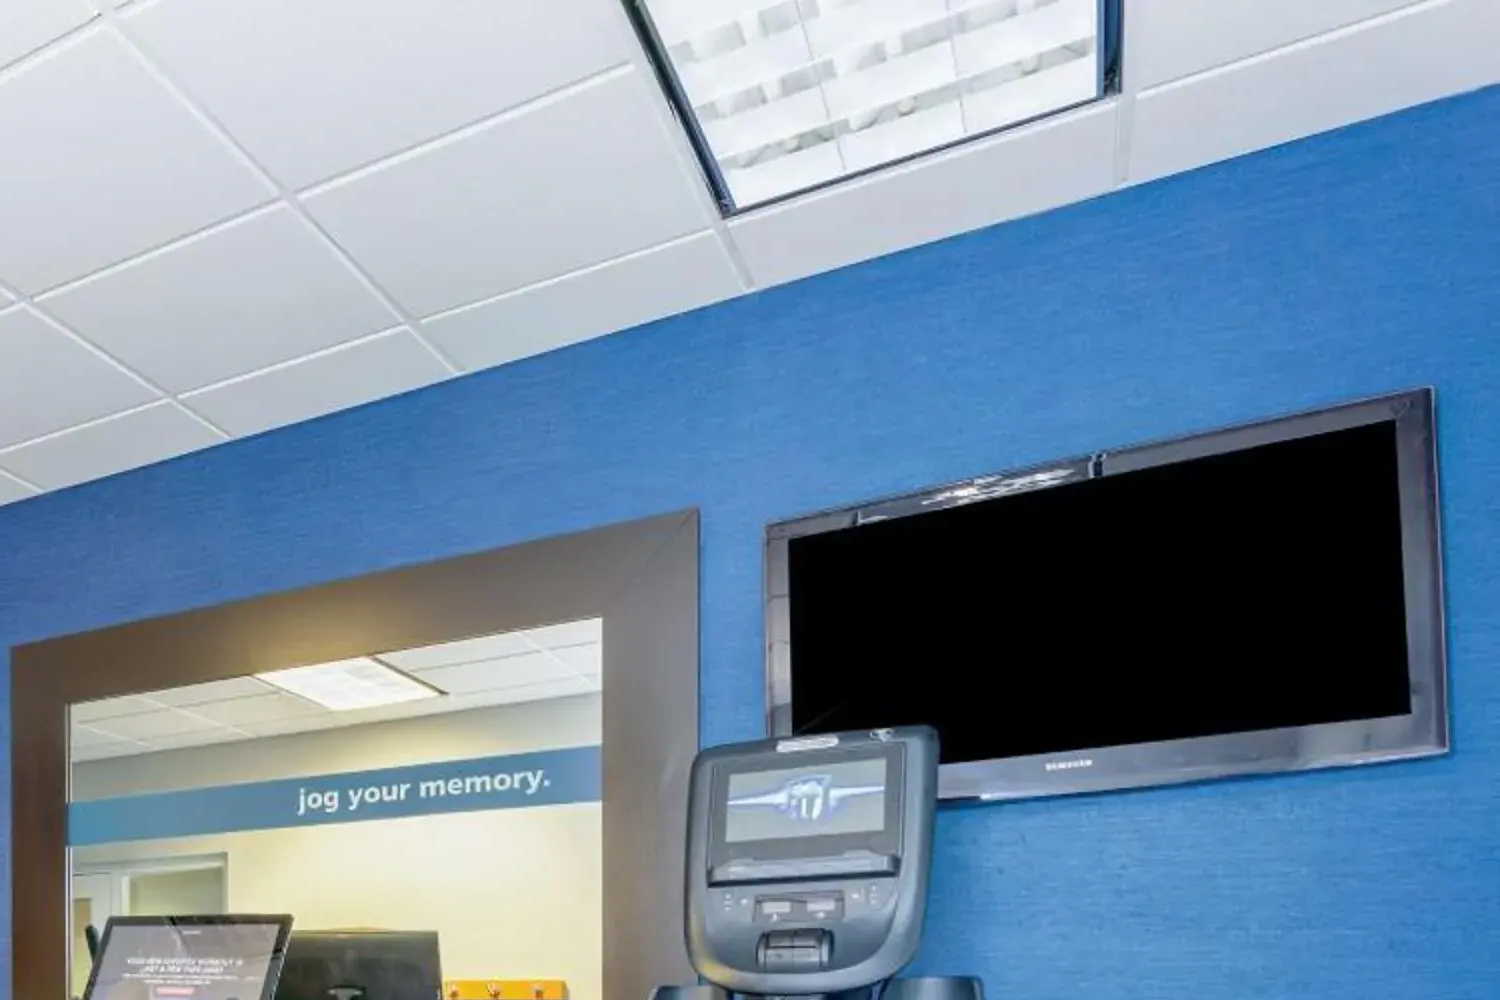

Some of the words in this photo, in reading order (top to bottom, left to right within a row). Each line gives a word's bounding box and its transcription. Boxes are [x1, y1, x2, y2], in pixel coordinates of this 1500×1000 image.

[297, 787, 340, 816] jog
[348, 782, 412, 811] your
[419, 769, 551, 798] memory.
